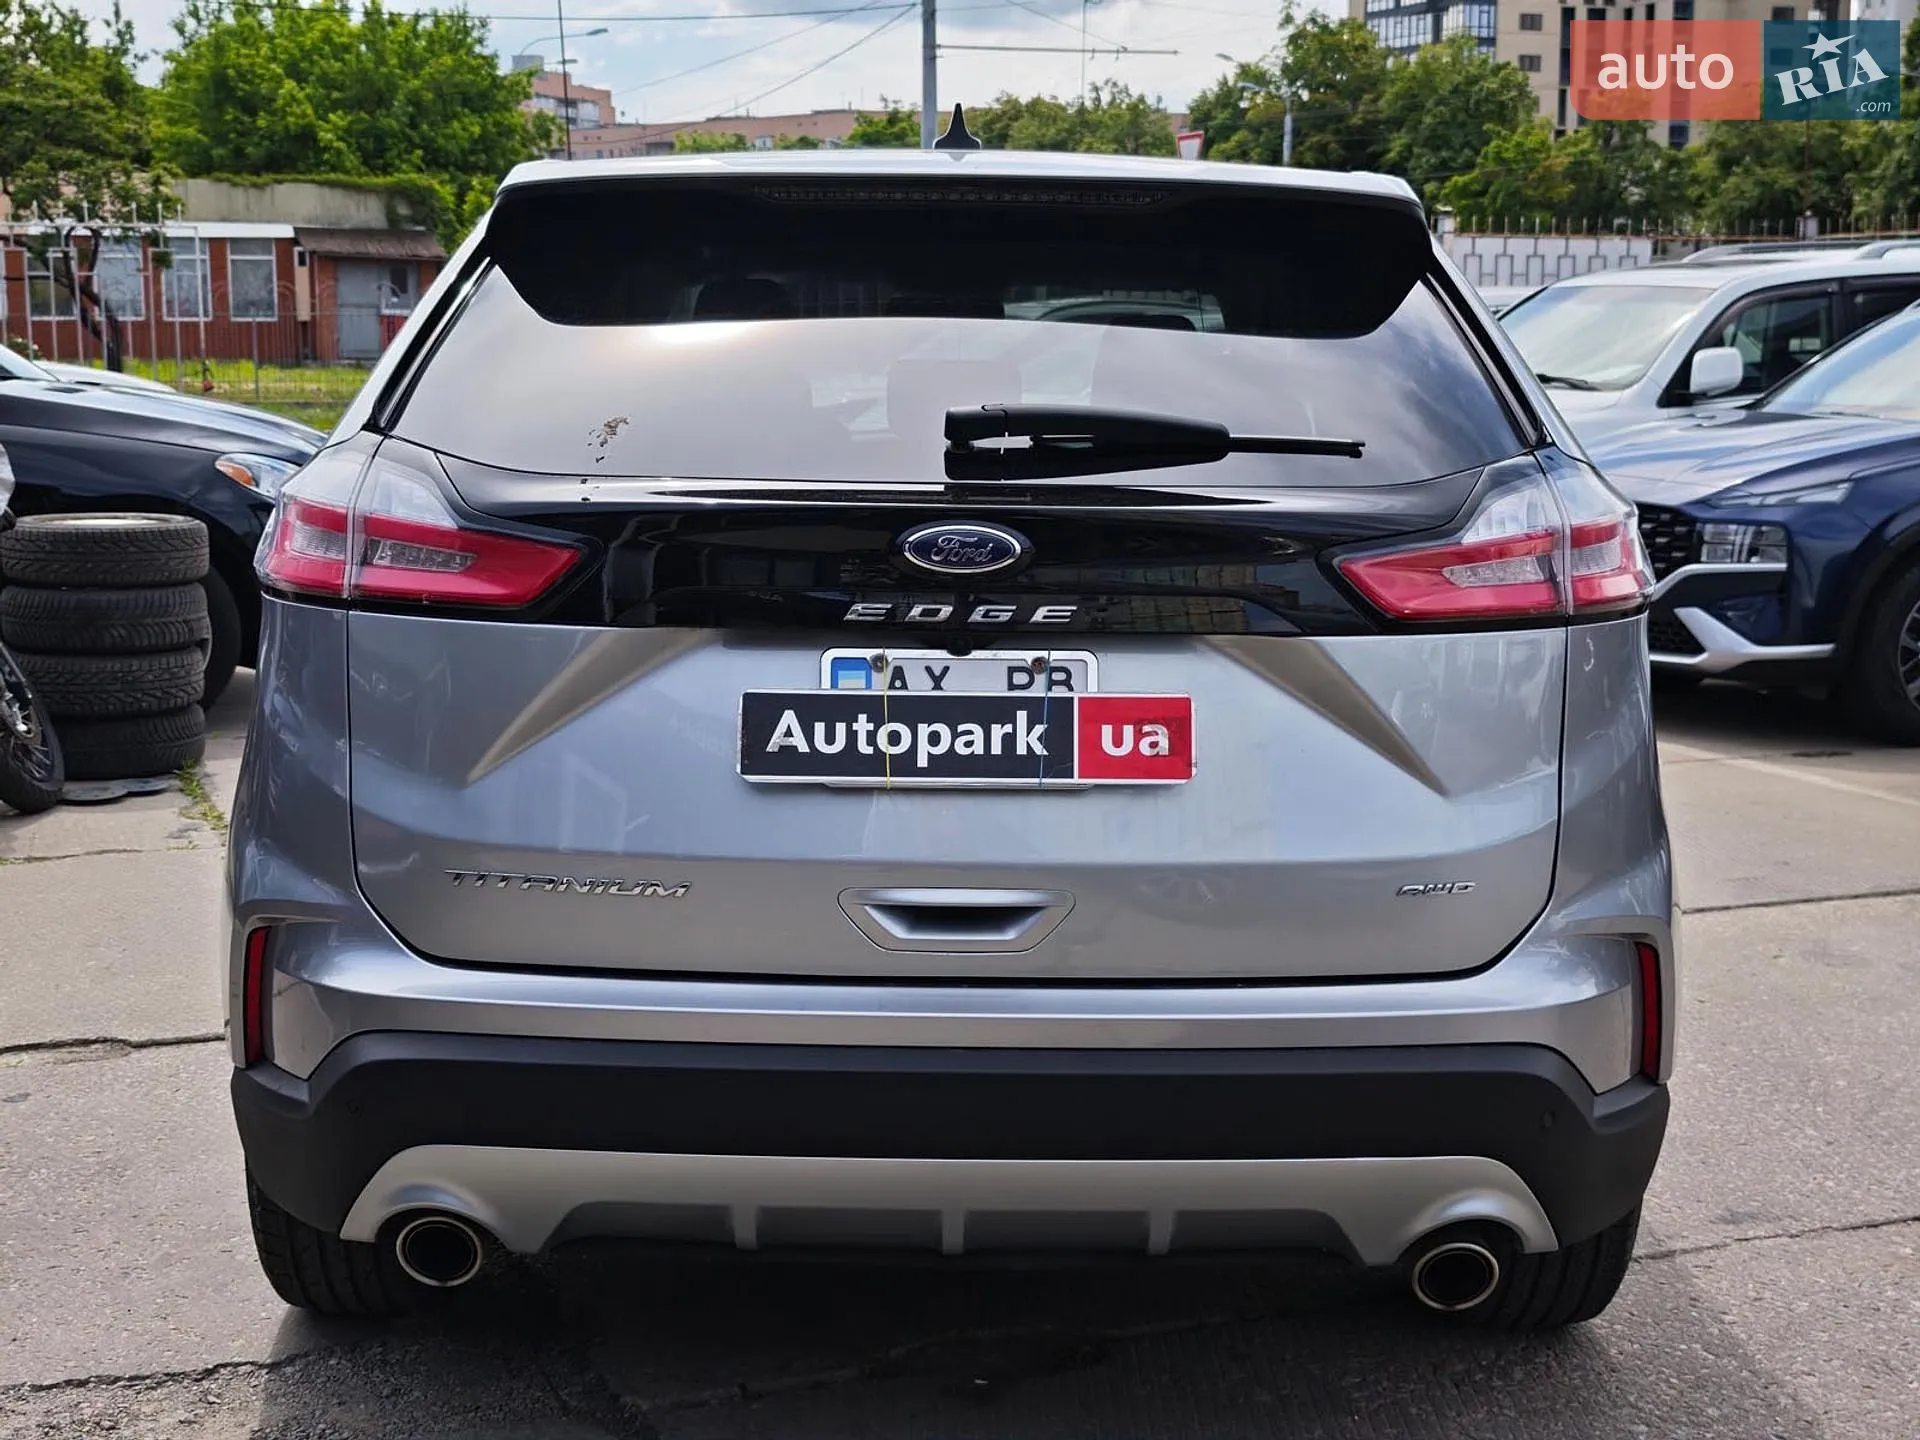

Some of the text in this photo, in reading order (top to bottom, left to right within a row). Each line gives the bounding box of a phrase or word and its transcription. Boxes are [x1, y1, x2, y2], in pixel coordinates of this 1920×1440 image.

[930, 534, 994, 564] Ford
[843, 602, 1078, 625] EDGE
[766, 708, 1172, 769] Autopark ua
[444, 868, 692, 899] TITANIUM
[1396, 881, 1477, 896] AWD
